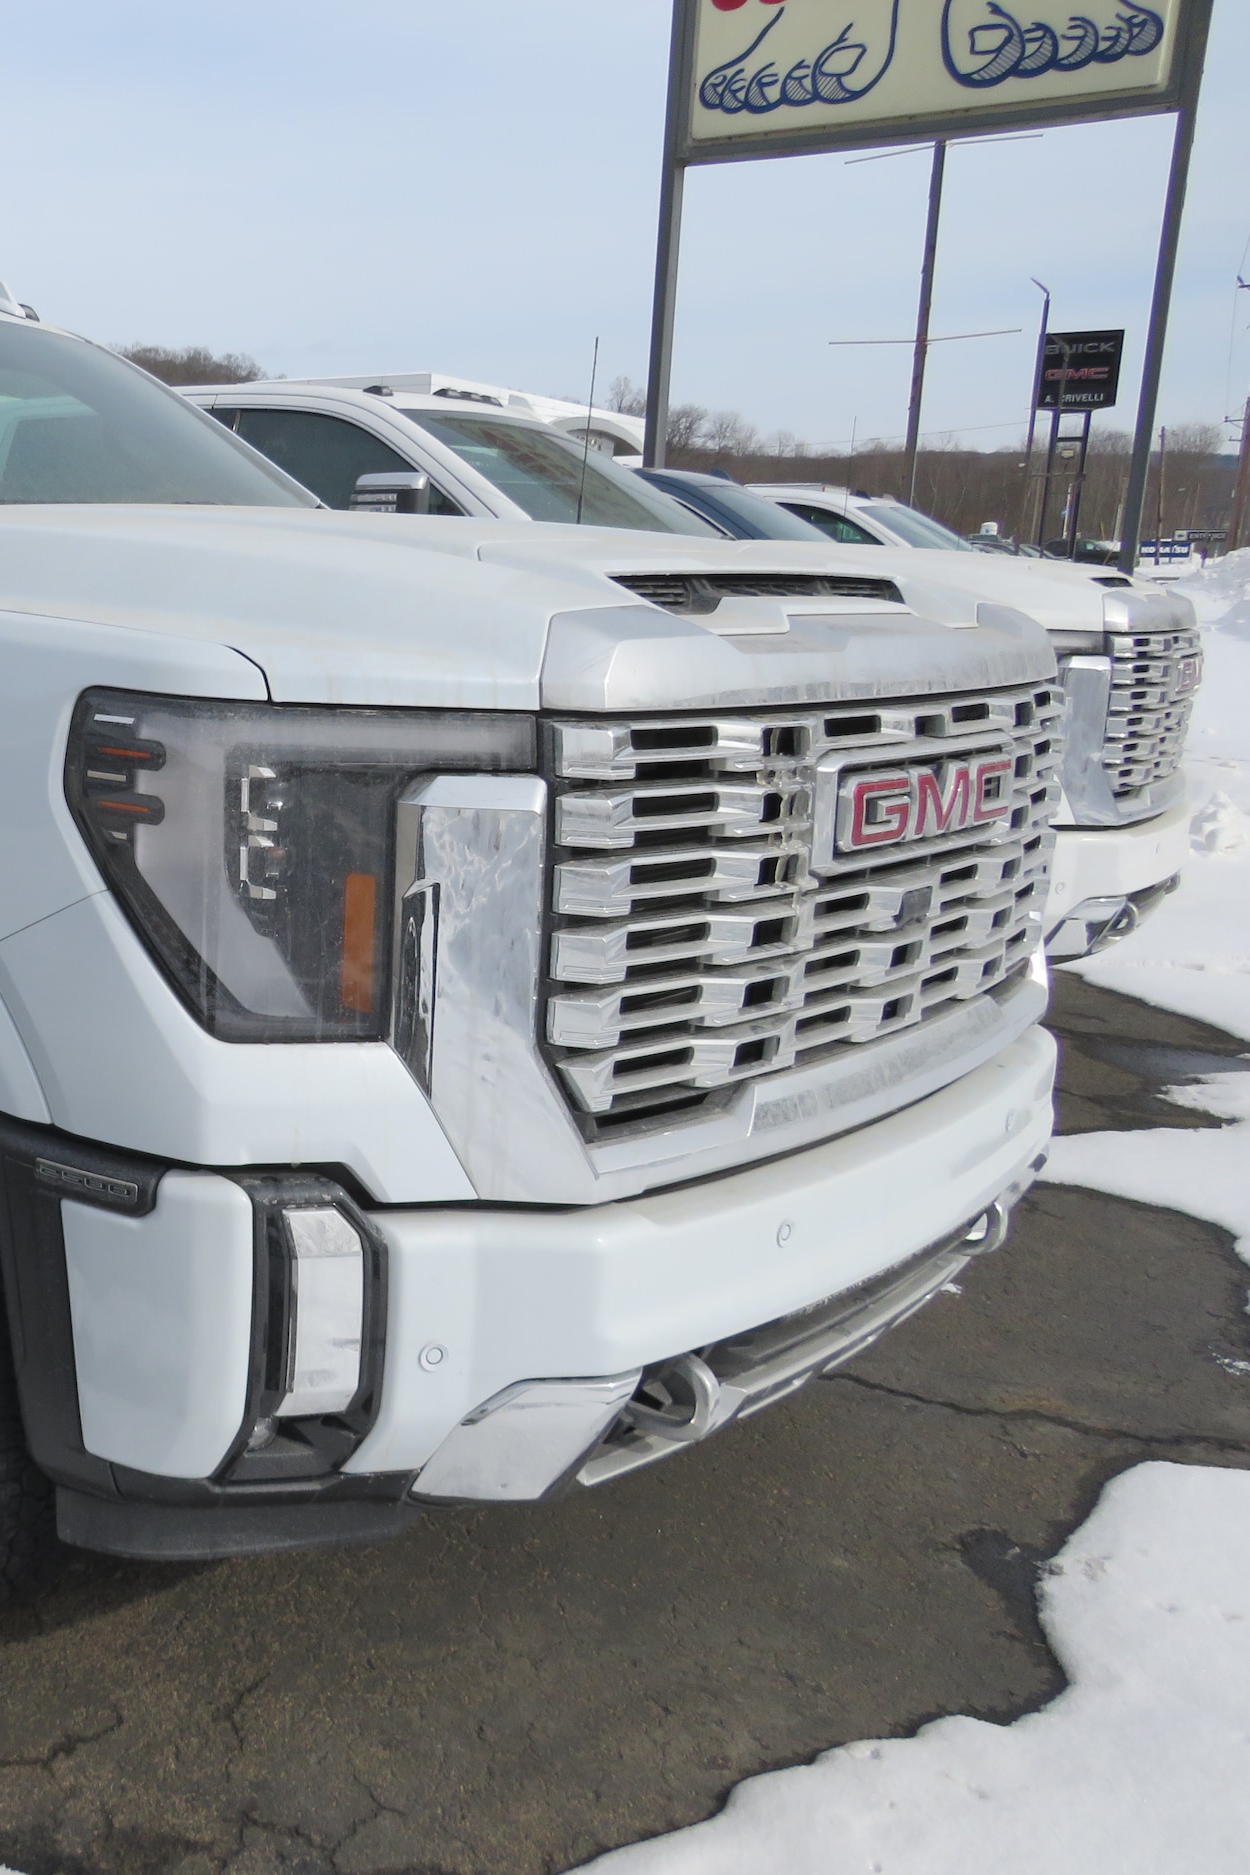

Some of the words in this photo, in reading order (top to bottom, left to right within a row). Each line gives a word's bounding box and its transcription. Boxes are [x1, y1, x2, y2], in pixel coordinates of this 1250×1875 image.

[1044, 342, 1116, 355] BUICK
[1044, 367, 1110, 380] GMC
[1190, 531, 1227, 540] ENTRNCE
[842, 756, 1014, 850] GMC
[40, 1165, 131, 1198] 2500
